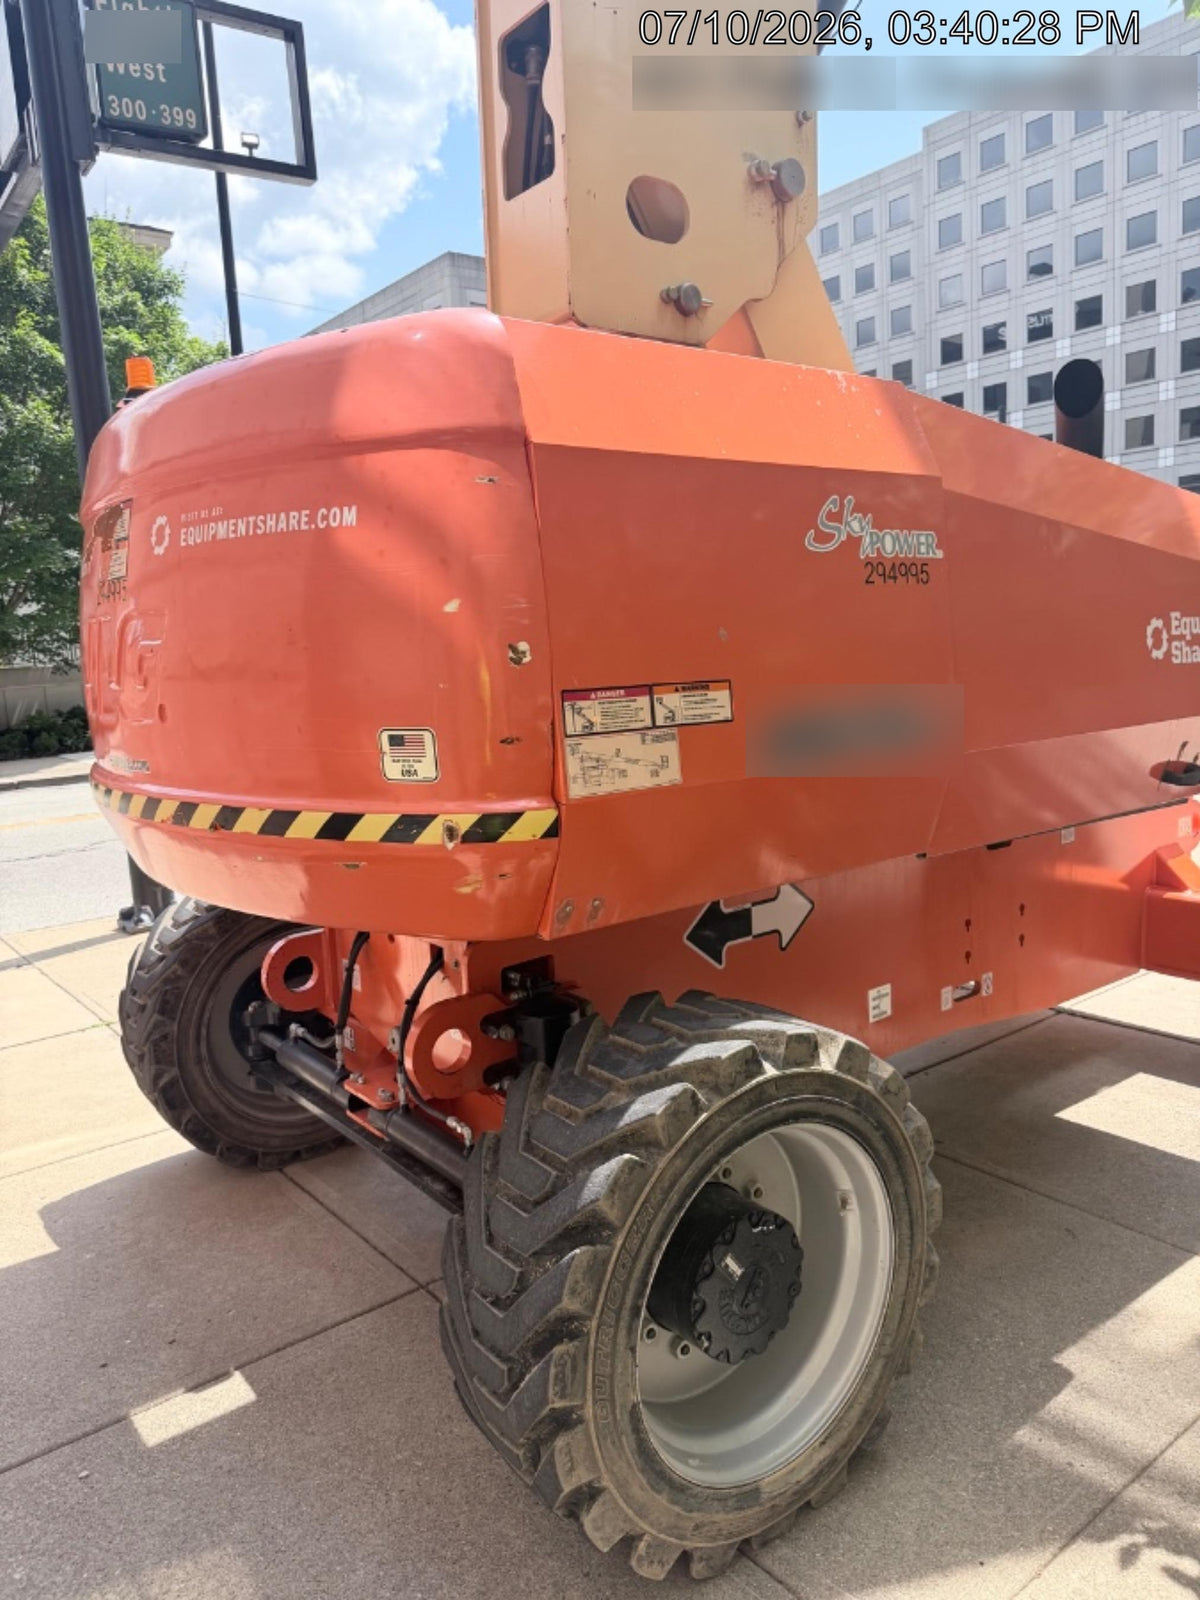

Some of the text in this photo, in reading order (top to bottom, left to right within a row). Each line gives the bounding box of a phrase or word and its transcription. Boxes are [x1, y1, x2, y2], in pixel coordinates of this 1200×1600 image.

[180, 504, 358, 548] EQUIPMENTSHARE.COM
[805, 495, 944, 559] Sky POWER
[864, 561, 931, 585] 294995
[401, 768, 418, 778] USA
